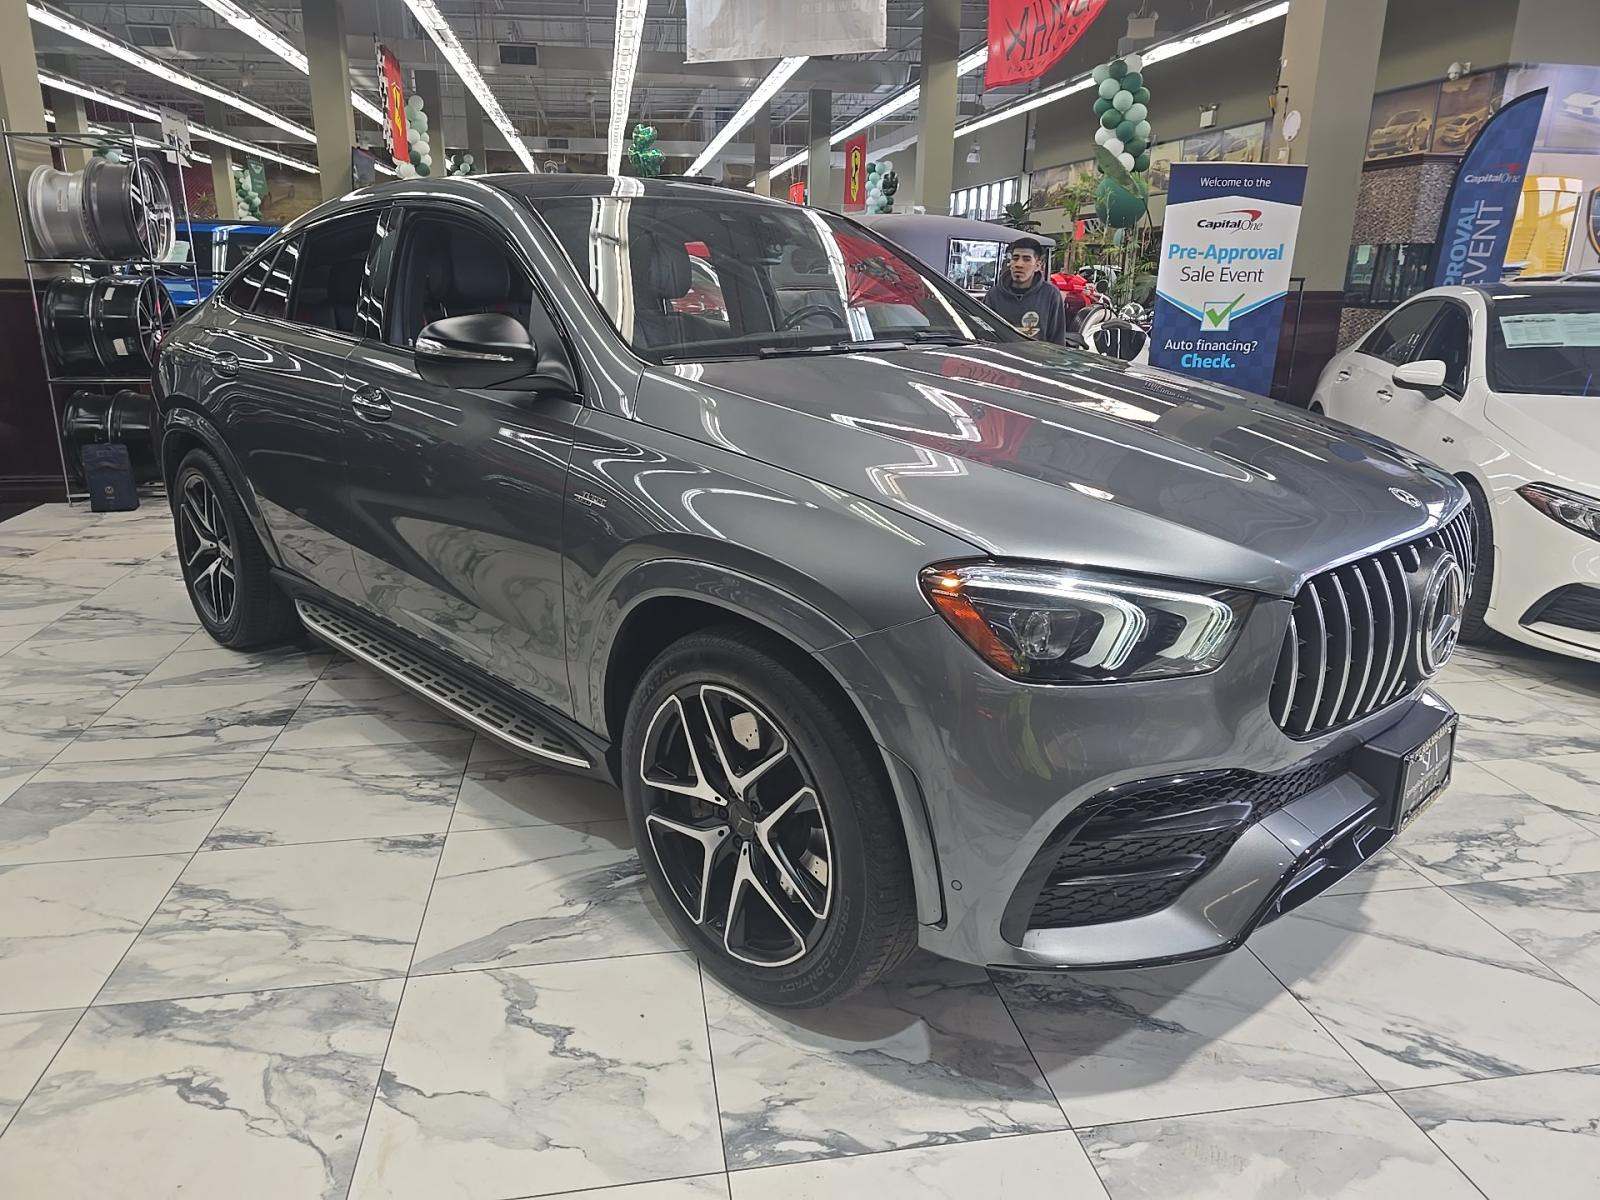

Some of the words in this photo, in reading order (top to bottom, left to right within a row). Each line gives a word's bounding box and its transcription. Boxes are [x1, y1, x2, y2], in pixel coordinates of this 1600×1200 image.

[1200, 177, 1241, 188] Welcome
[1243, 178, 1254, 188] to
[1255, 178, 1272, 188] the
[1168, 244, 1284, 264] Pre-Approval
[1180, 266, 1215, 282] Sale
[1219, 267, 1264, 282] Event
[1164, 339, 1193, 351] Auto
[1196, 339, 1258, 354] financing?
[1181, 353, 1236, 368] Check.
